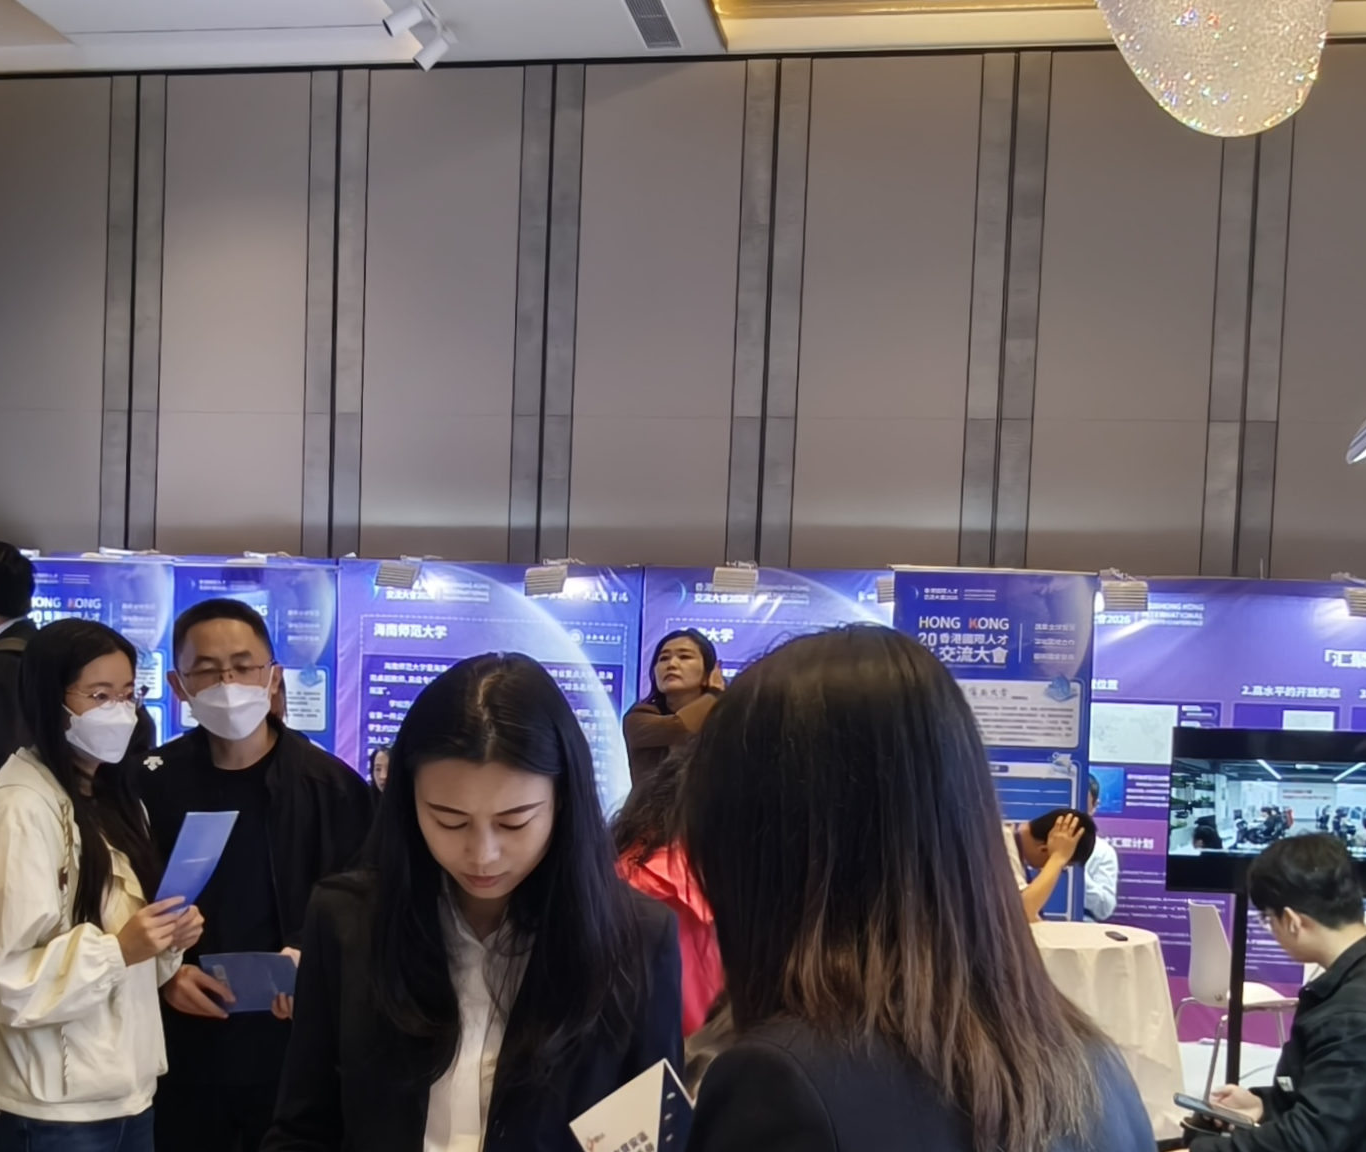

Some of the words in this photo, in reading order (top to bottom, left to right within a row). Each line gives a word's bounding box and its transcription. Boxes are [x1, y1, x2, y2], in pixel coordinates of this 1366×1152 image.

[919, 616, 961, 629] HONG
[969, 617, 1009, 630] KONG
[374, 623, 448, 639] 海南师范大学
[940, 633, 1009, 645] 香港國際人才
[939, 646, 1009, 663] 交流大會
